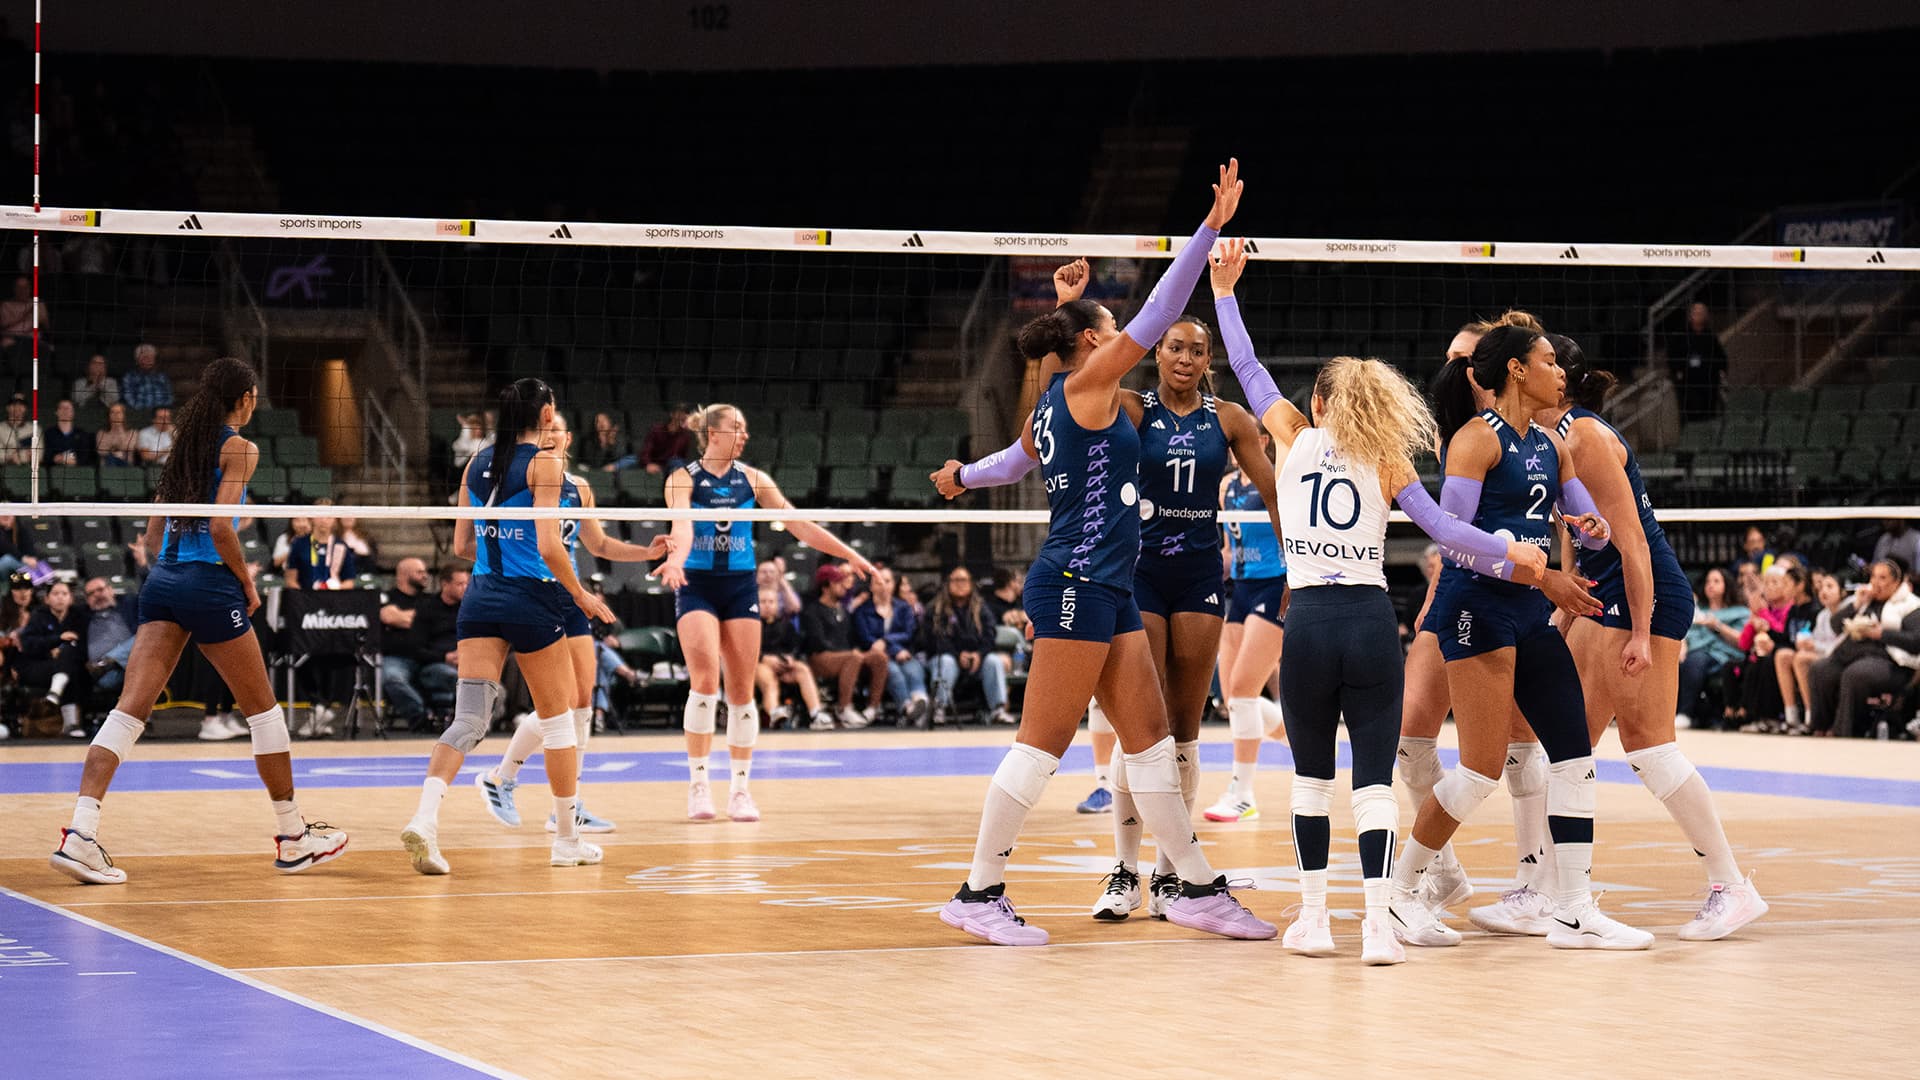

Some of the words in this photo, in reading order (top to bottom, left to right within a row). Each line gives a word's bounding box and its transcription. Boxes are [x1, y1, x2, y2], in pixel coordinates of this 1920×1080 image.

[690, 5, 729, 31] 102
[279, 217, 316, 229] sports
[317, 219, 363, 231] imports
[645, 227, 680, 239] sports
[681, 228, 724, 241] imports
[993, 236, 1026, 247] sports
[1027, 237, 1069, 249] imports
[1326, 241, 1357, 252] sports
[1357, 242, 1397, 254] imports
[1642, 247, 1673, 258] sports
[1673, 248, 1712, 260] imports
[1167, 448, 1195, 456] AUSTIN
[1165, 458, 1197, 493] 11
[1527, 473, 1548, 481] AUSTIN
[1300, 472, 1361, 531] 10
[1525, 483, 1547, 521] 2
[1158, 505, 1213, 520] headspace
[1284, 538, 1380, 561] REVOLVE
[1058, 586, 1077, 631] AUSTIN
